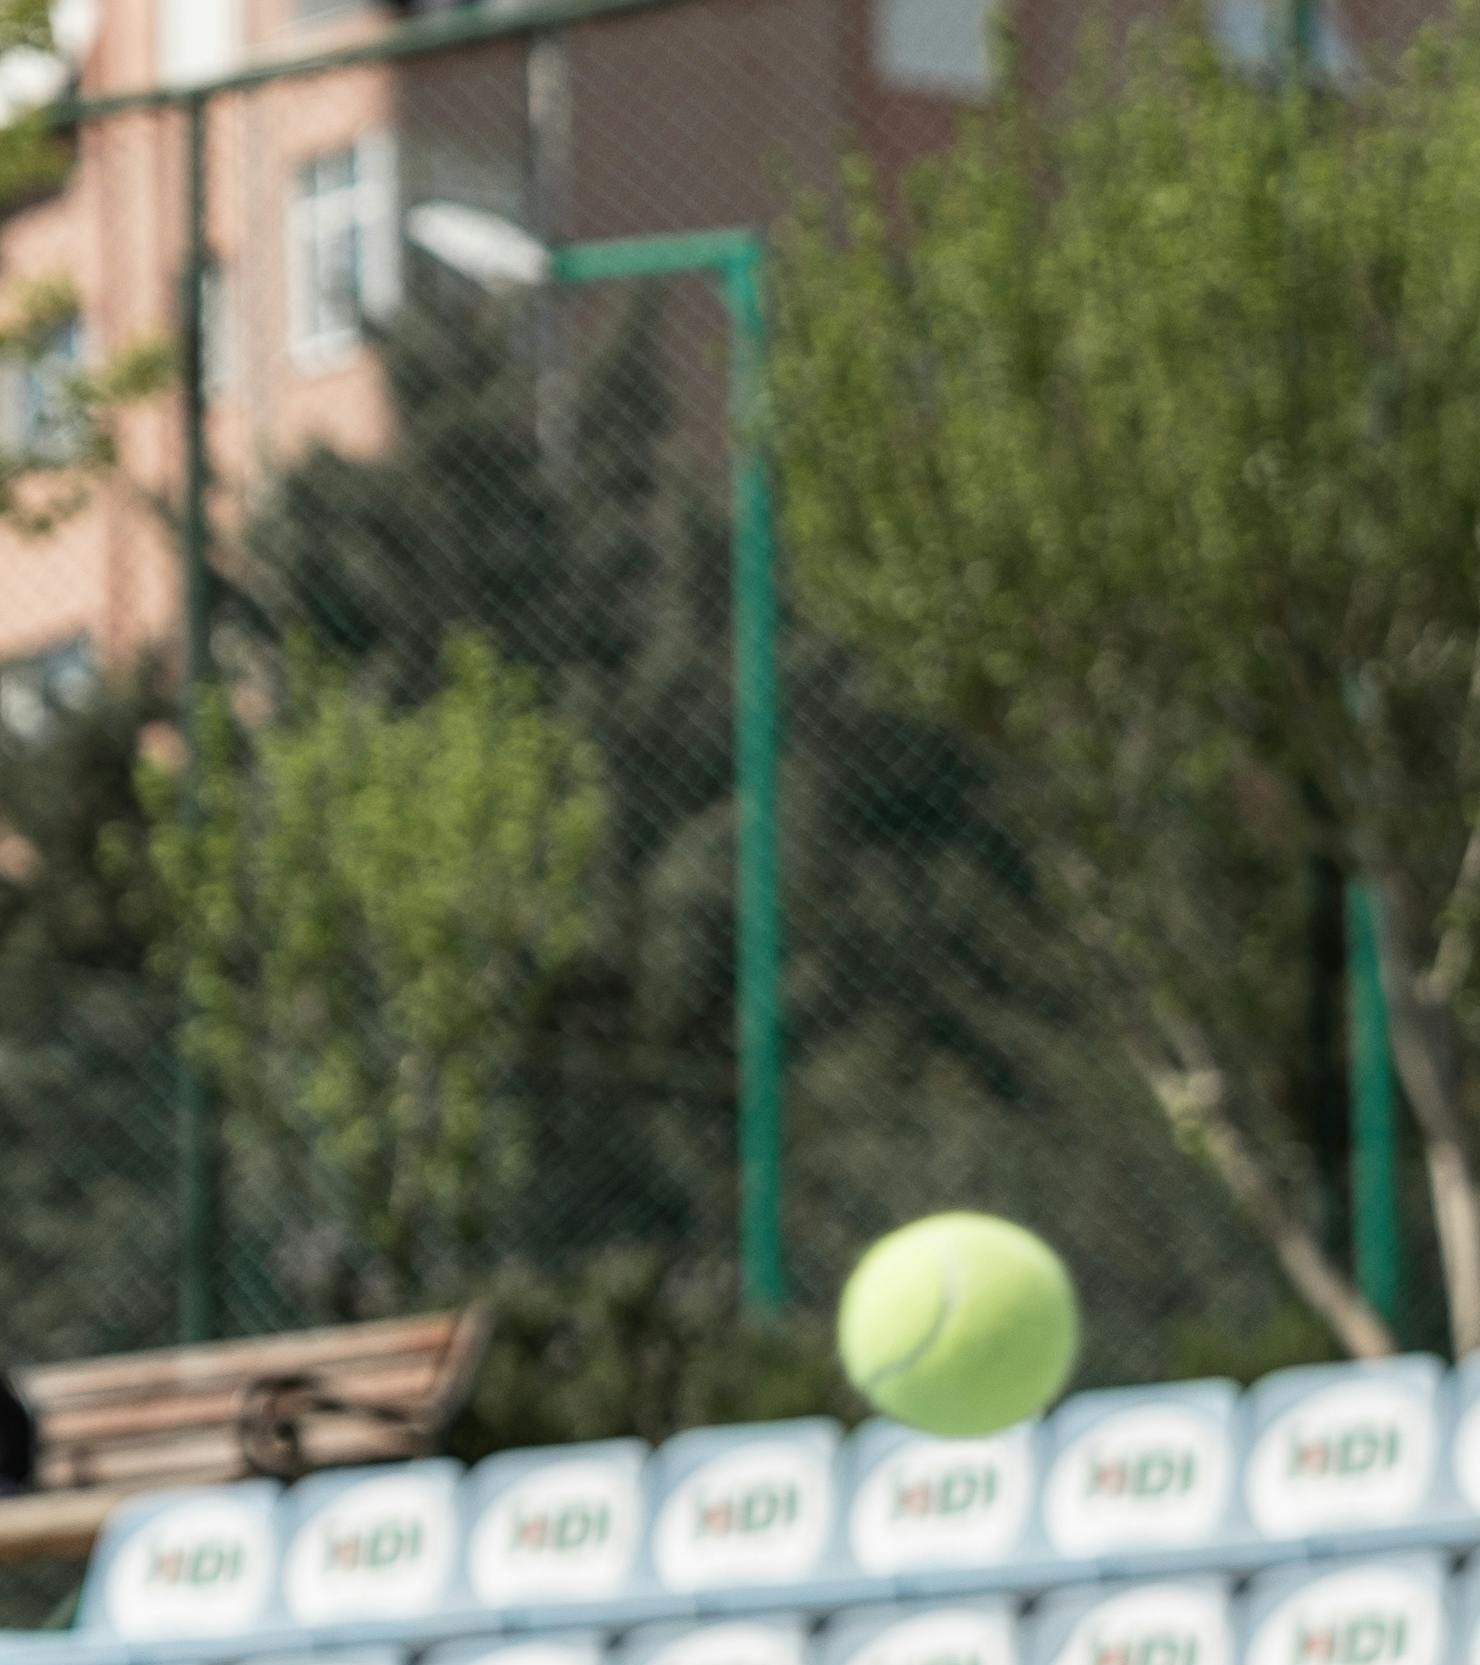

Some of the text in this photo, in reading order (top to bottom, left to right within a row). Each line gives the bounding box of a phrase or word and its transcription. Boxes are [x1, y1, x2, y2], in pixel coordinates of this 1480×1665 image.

[1084, 1444, 1196, 1502] HDI
[1286, 1421, 1400, 1479] HDI
[693, 1482, 799, 1535] HDI
[890, 1461, 998, 1520] HDI
[322, 1520, 423, 1573] HDI
[507, 1496, 609, 1555] HDI
[146, 1539, 245, 1587] HDI
